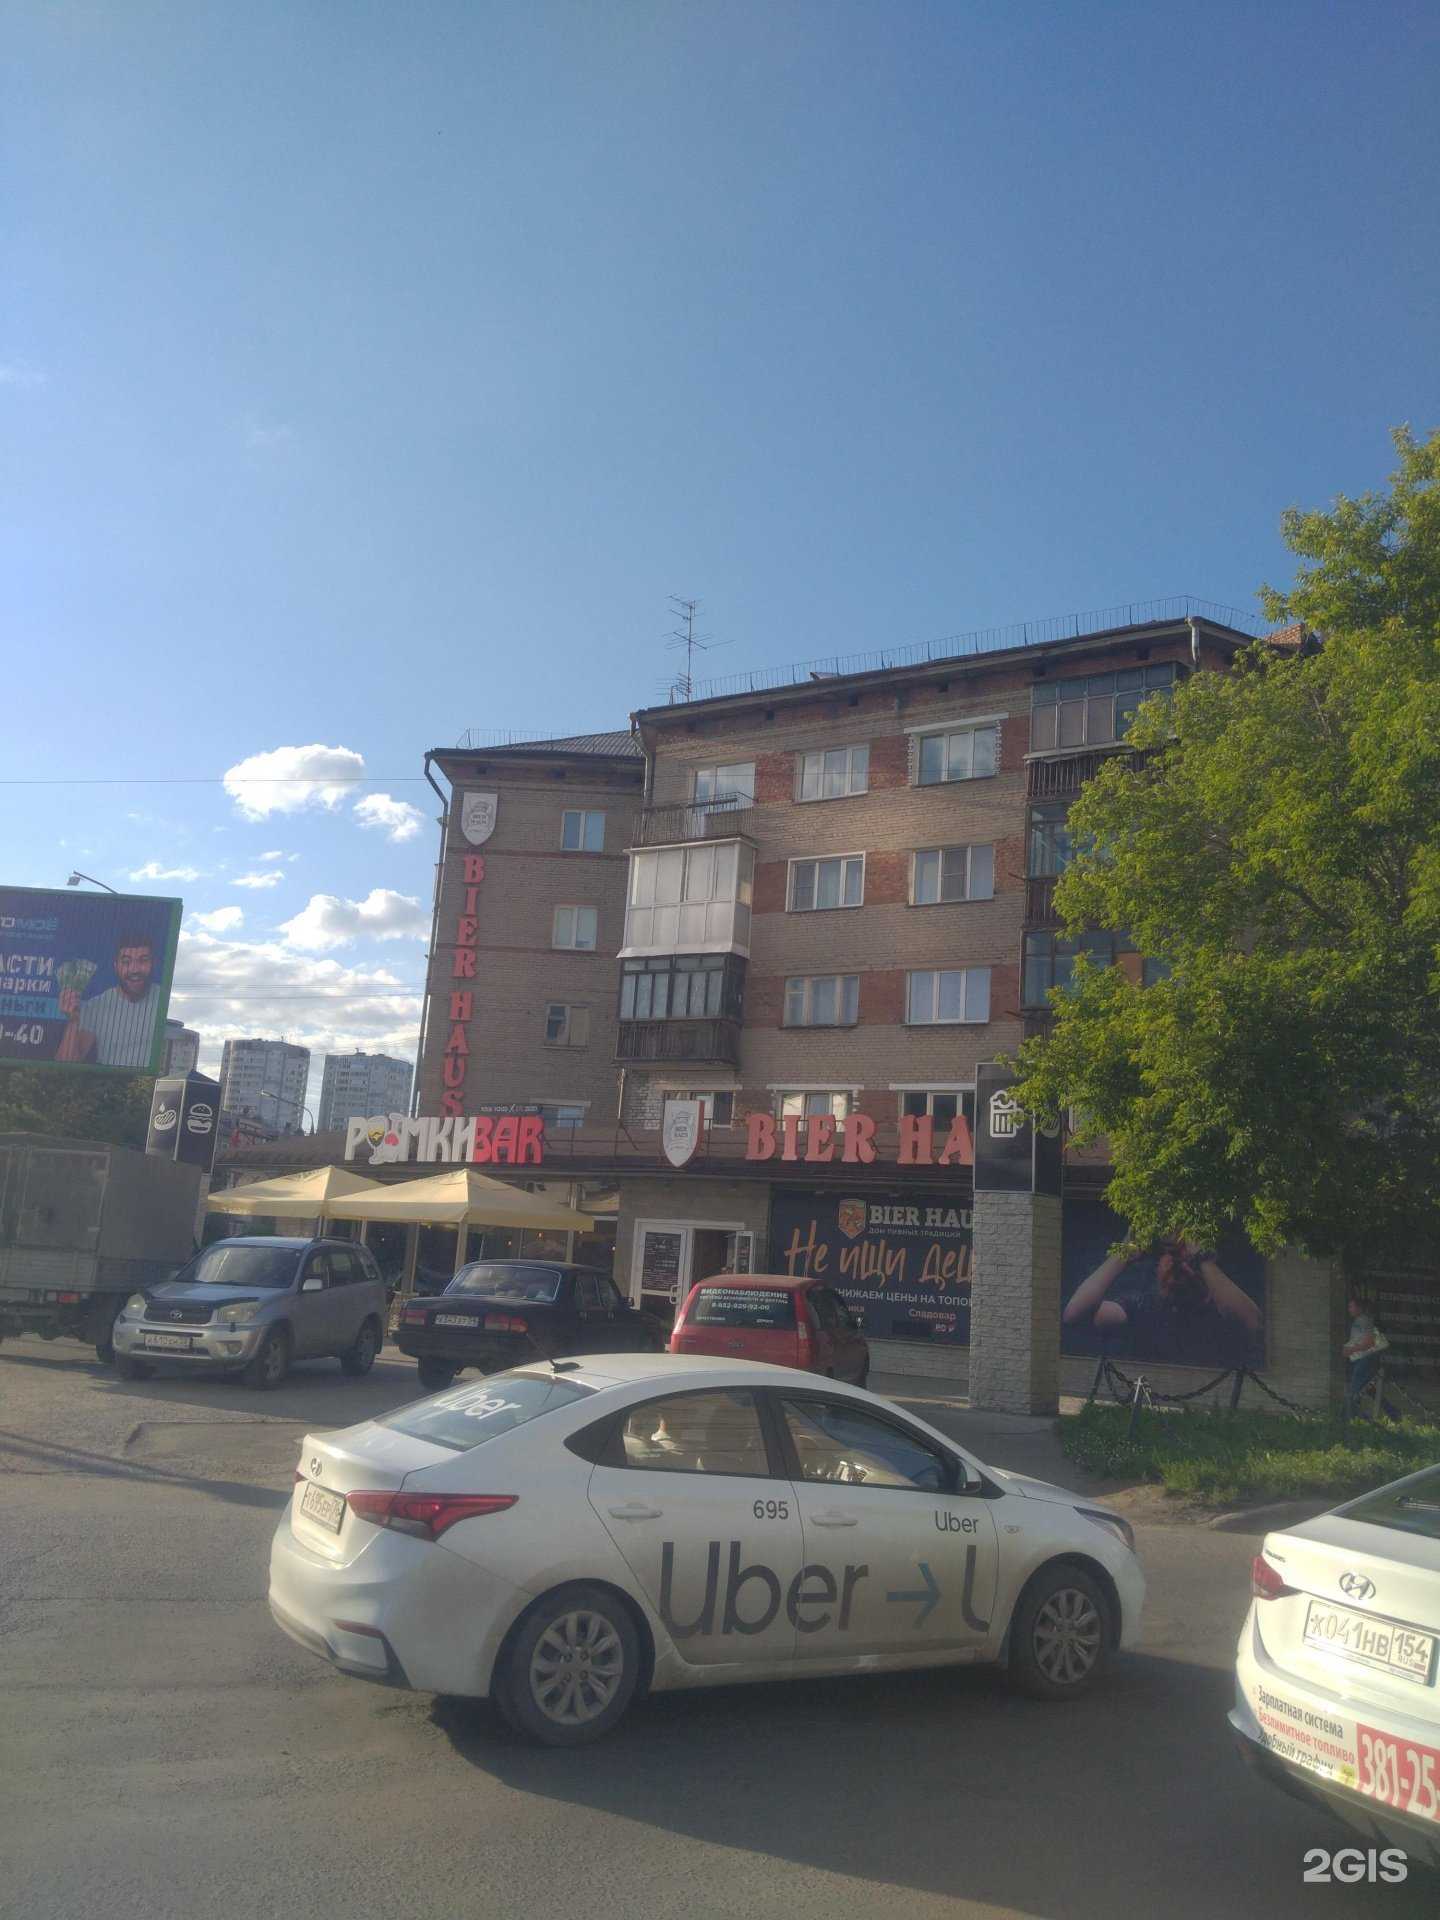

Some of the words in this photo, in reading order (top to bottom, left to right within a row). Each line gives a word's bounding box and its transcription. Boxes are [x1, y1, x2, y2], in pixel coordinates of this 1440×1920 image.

[452, 853, 485, 978] BIER
[442, 991, 473, 1118] HAUS
[745, 1112, 879, 1164] BIER
[869, 1205, 920, 1226] BIER
[834, 1287, 883, 1301] НИЖАЕМ
[886, 1292, 918, 1304] ЦЕНЫ
[920, 1294, 935, 1304] НА
[752, 1499, 789, 1520] 695
[934, 1510, 980, 1534] Uber
[659, 1540, 870, 1639] Uber
[1304, 1711, 1344, 1739] система
[1312, 1735, 1355, 1765] топливо
